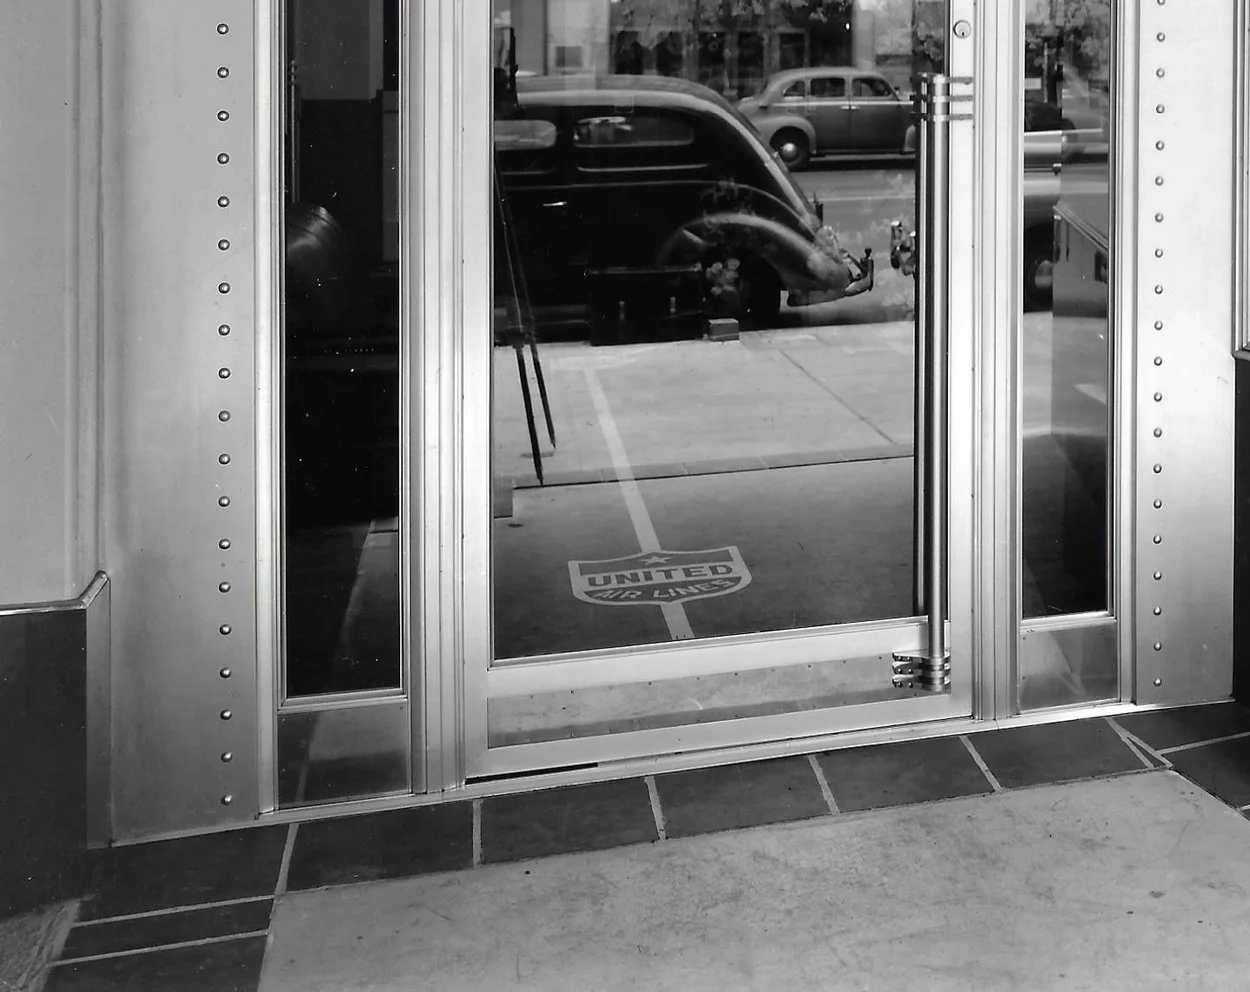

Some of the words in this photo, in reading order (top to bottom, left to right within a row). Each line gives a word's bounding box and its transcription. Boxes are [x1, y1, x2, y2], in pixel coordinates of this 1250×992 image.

[587, 564, 734, 587] UNITED
[592, 589, 642, 600] AIR
[653, 578, 737, 599] LINES
